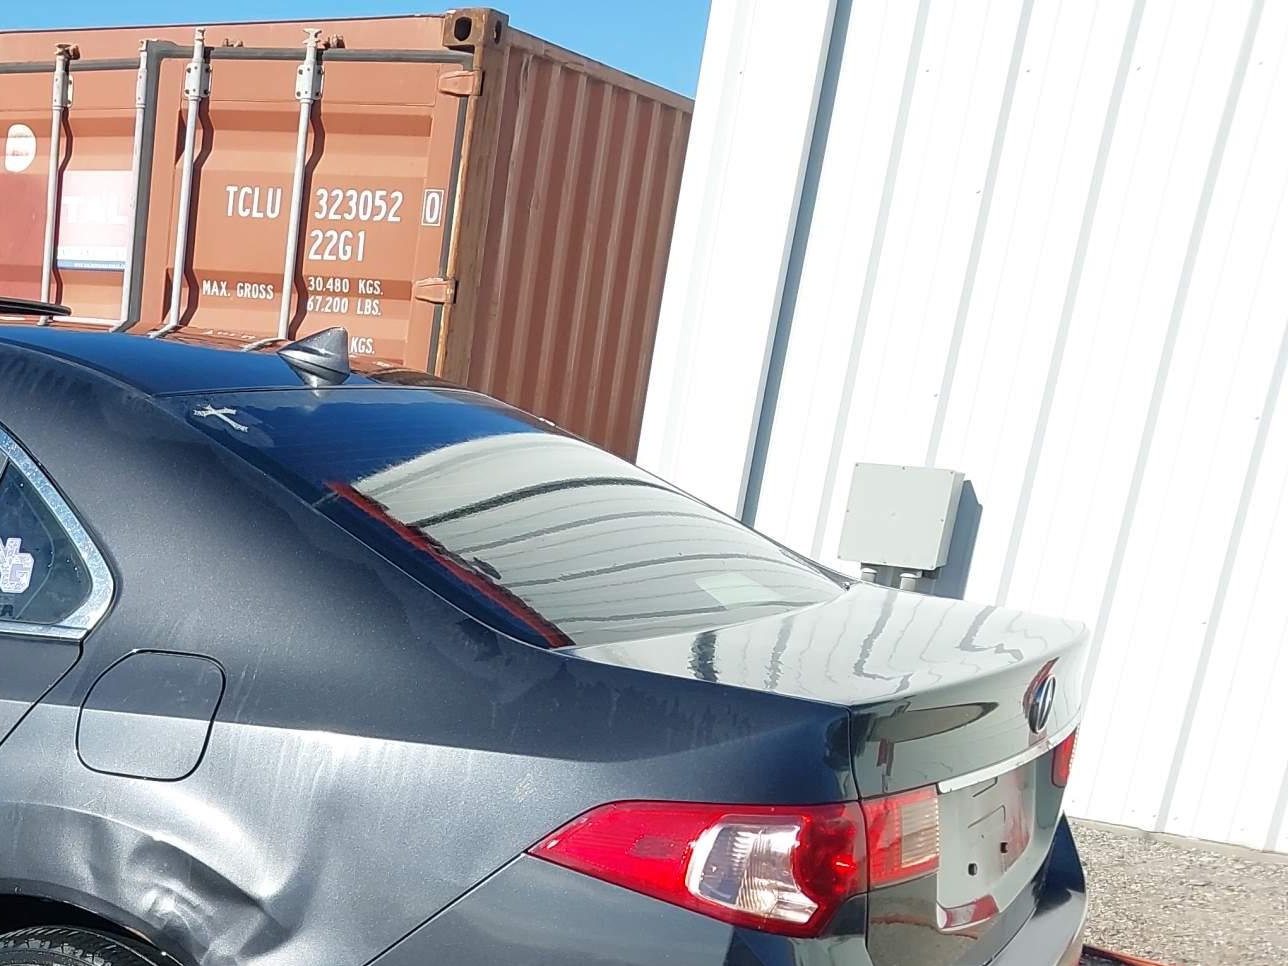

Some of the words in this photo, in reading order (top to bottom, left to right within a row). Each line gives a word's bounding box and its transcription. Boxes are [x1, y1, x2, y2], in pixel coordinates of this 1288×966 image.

[225, 185, 282, 218] TCLU
[314, 188, 403, 222] 323052
[424, 191, 440, 224] 0
[308, 229, 366, 262] 22G1
[202, 279, 231, 298] MAX.
[236, 282, 274, 300] GROSS
[307, 276, 350, 293] 30.480
[358, 279, 384, 296] KGS.
[306, 296, 349, 314] 67.200
[356, 298, 382, 316] LBS.
[350, 336, 375, 355] KGS.
